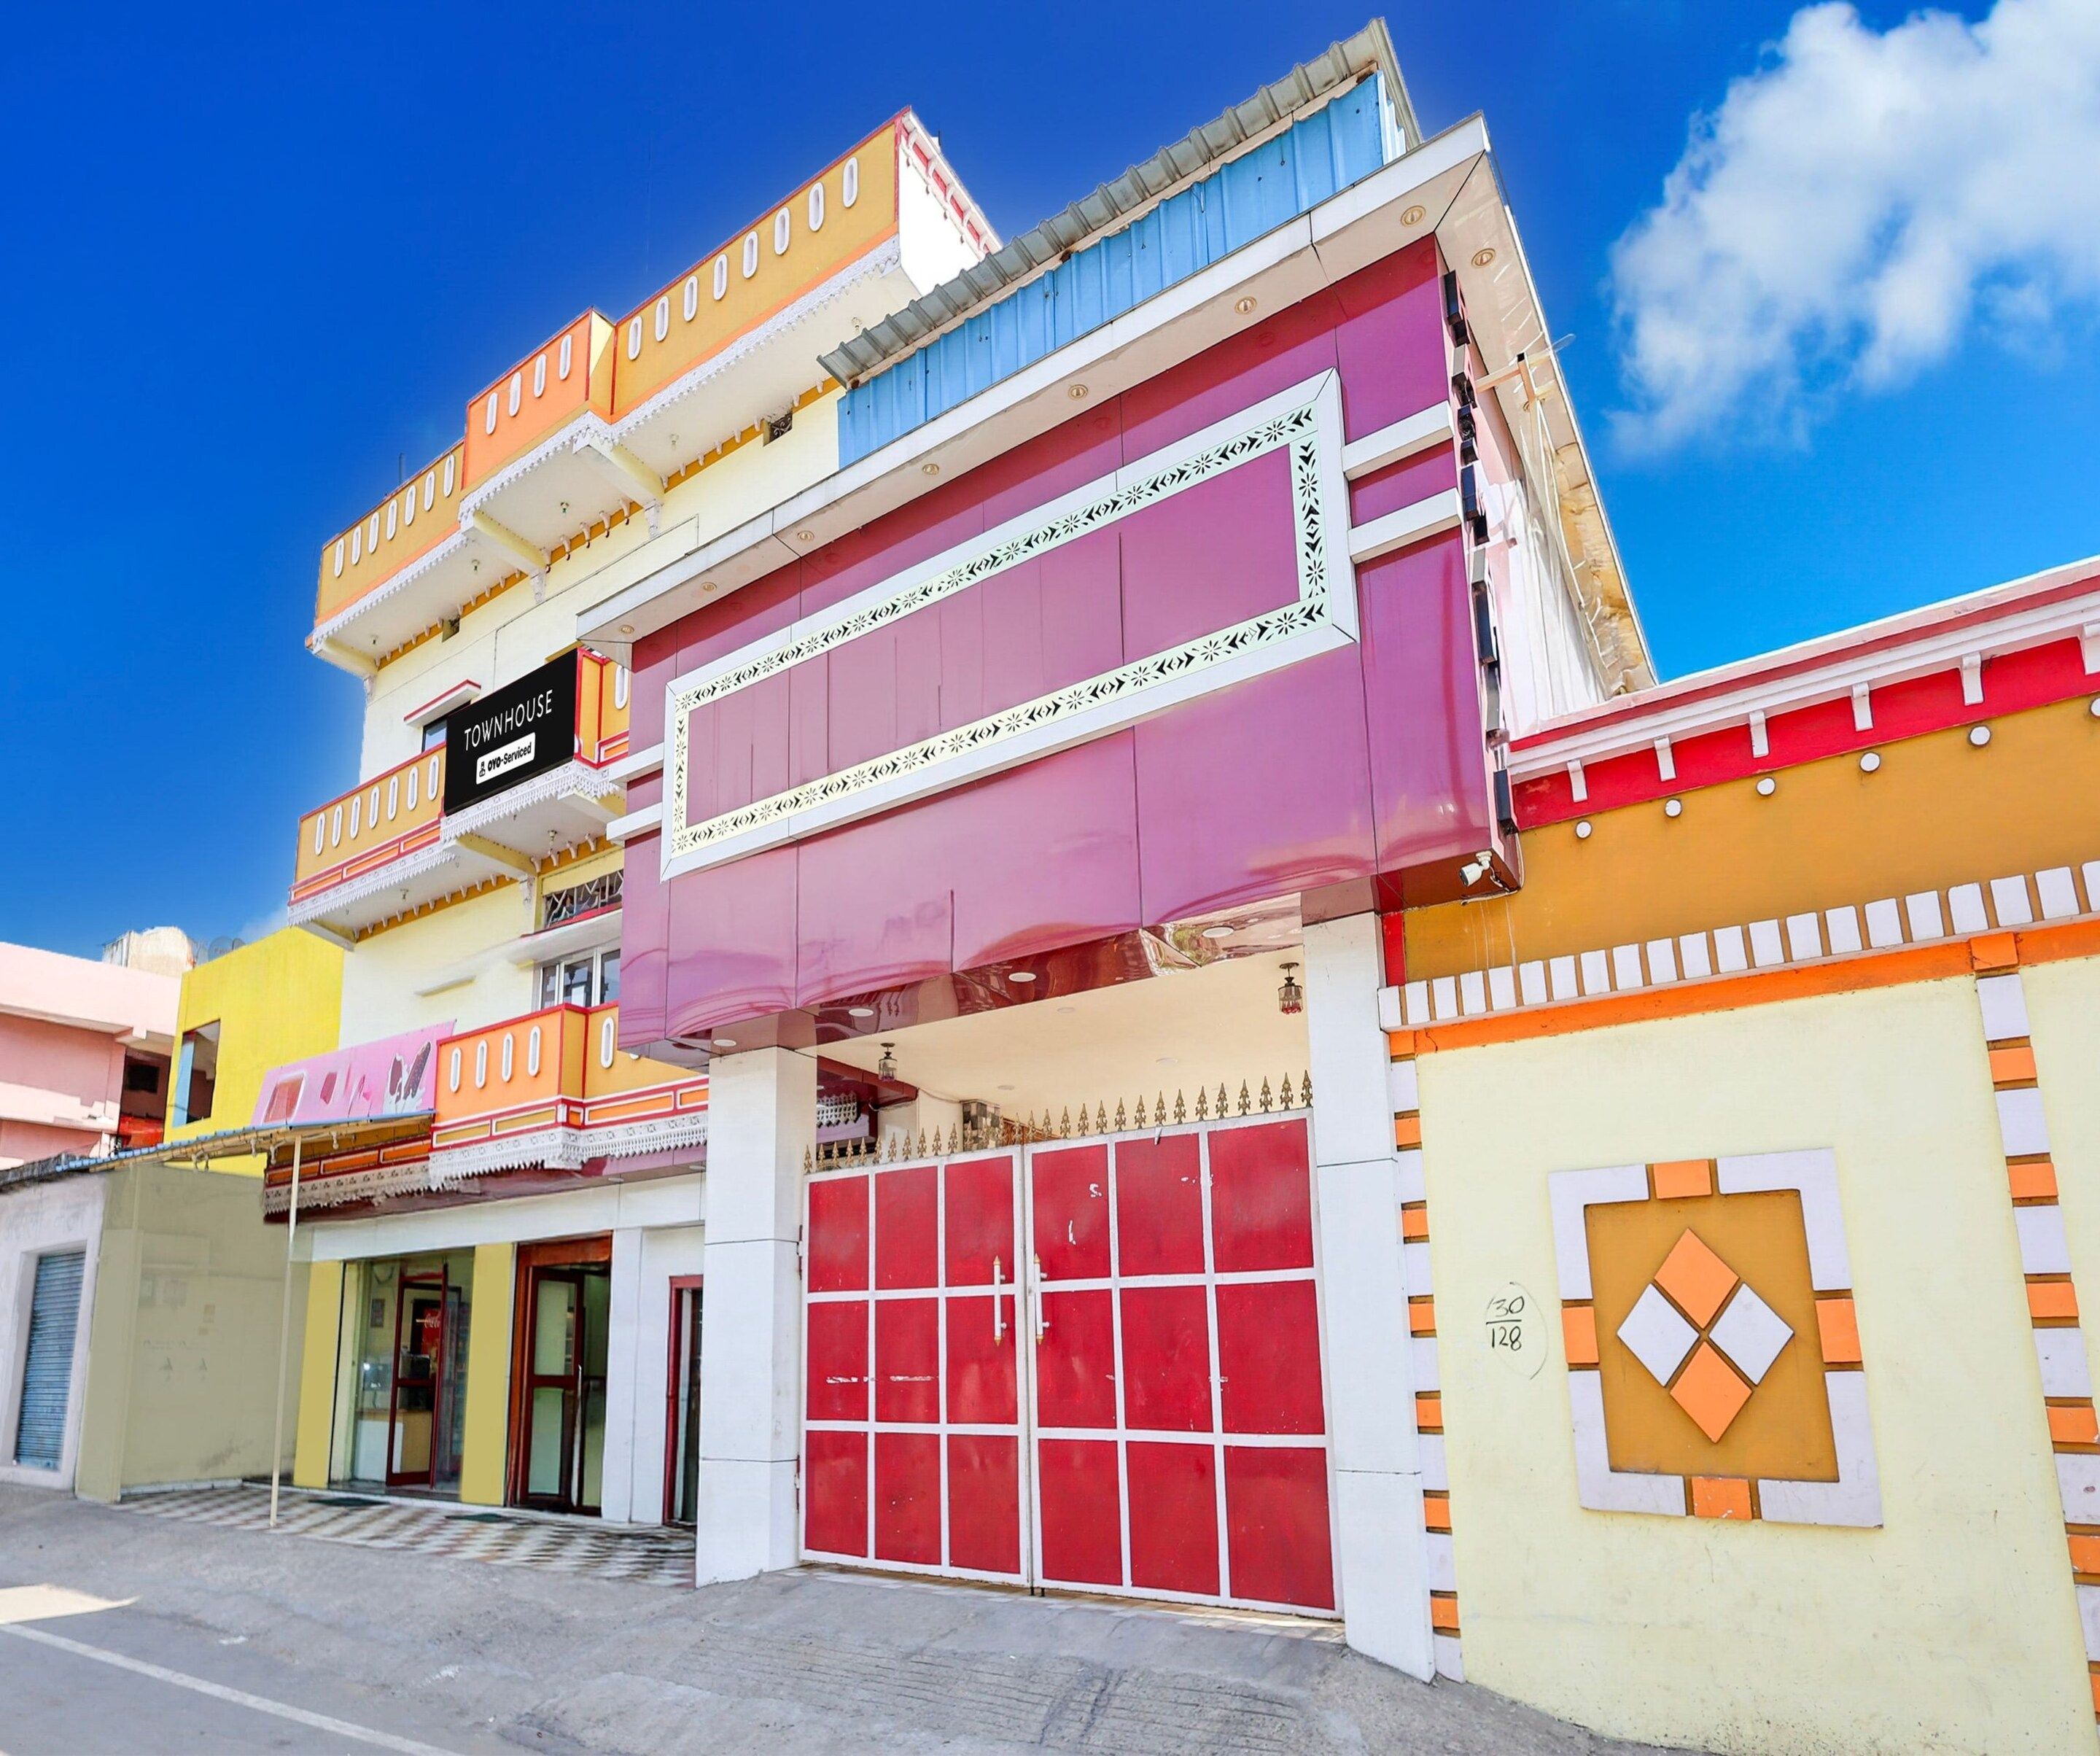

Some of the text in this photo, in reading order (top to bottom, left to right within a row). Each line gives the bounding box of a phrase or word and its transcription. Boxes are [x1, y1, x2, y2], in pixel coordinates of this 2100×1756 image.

[464, 690, 553, 751] TOWNHOUSE
[488, 742, 532, 772] OYO-Serviced
[1492, 1296, 1525, 1317] 30
[1491, 1326, 1522, 1351] 128
